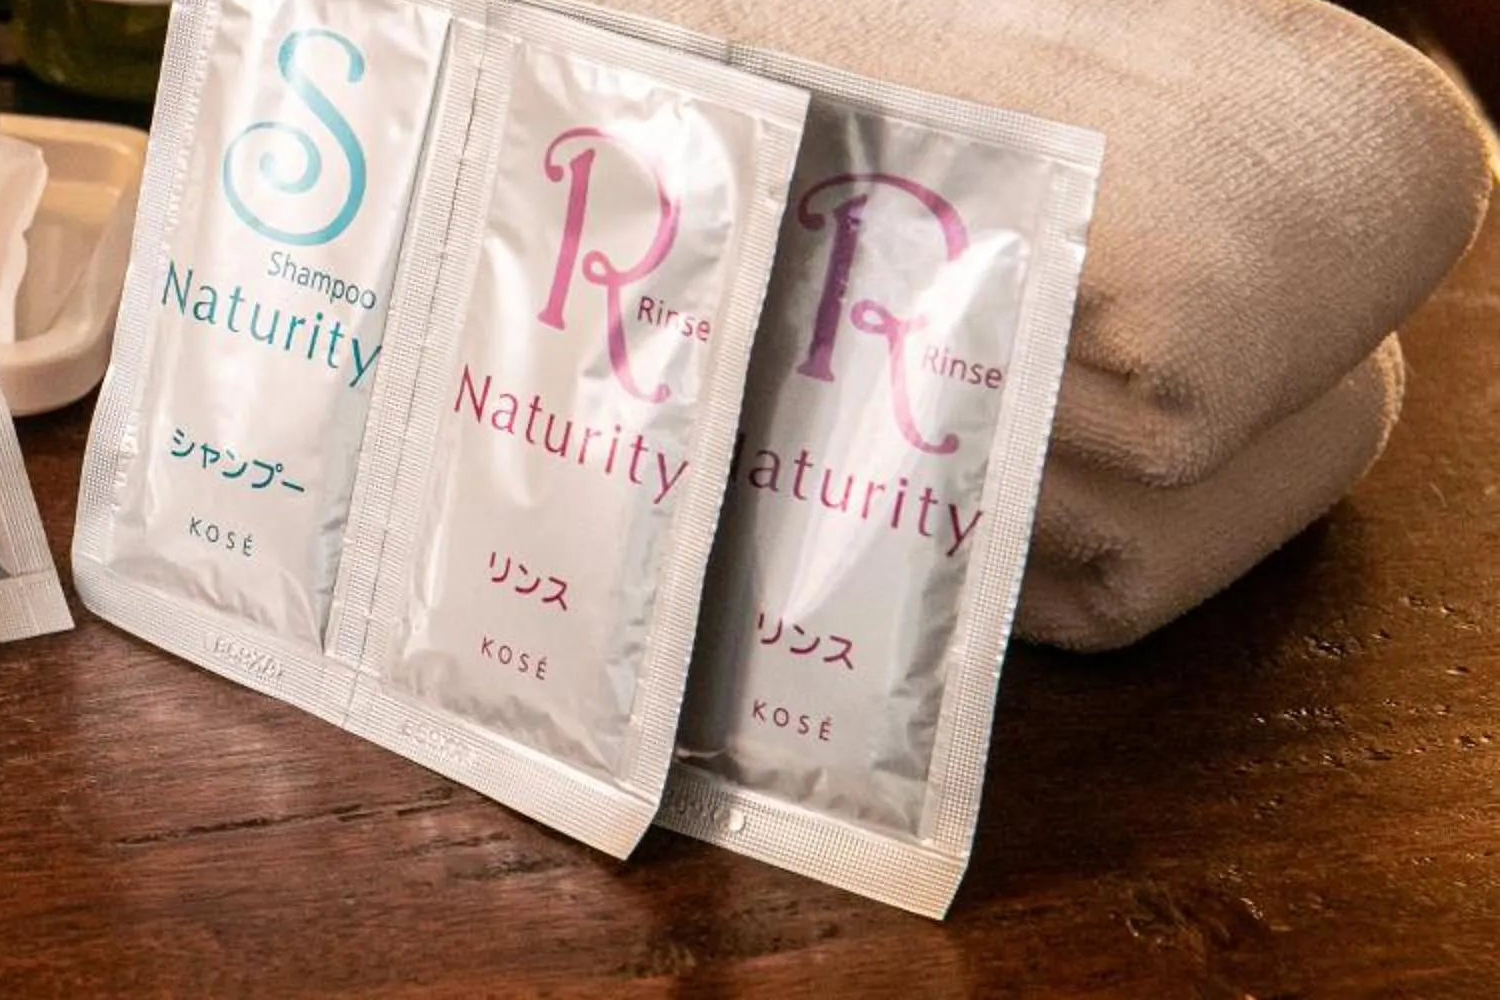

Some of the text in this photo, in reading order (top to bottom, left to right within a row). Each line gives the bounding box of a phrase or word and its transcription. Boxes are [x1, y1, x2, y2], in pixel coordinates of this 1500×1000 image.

[222, 27, 367, 247] S
[266, 250, 377, 310] Shampoo
[537, 126, 680, 404] R
[160, 259, 383, 388] Naturity
[636, 296, 710, 342] Rinse
[796, 172, 970, 456] R
[922, 345, 1002, 390] Rinse
[168, 427, 306, 494] シャンプー
[453, 364, 689, 505] Naturity
[189, 516, 255, 557] KOSÉ
[488, 551, 569, 612] リンス
[480, 634, 550, 681] KOSÉ
[756, 611, 857, 670] リンス
[751, 699, 835, 742] KOSÉ
